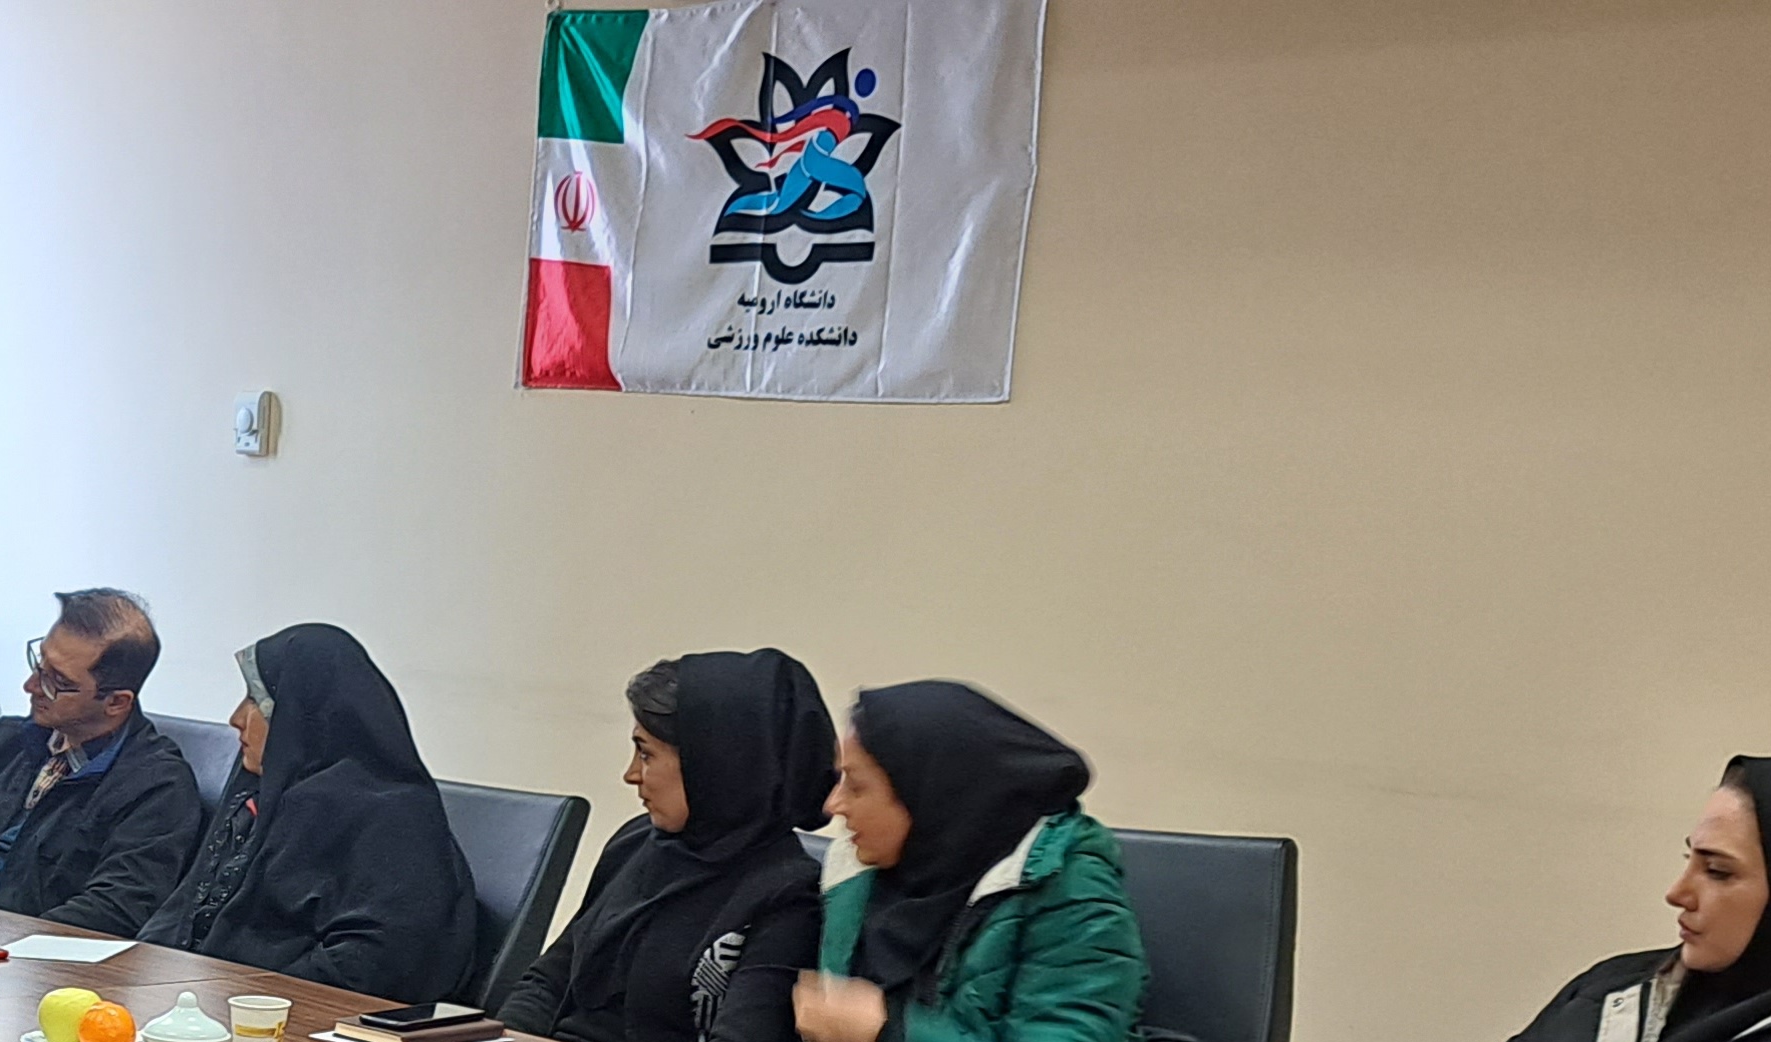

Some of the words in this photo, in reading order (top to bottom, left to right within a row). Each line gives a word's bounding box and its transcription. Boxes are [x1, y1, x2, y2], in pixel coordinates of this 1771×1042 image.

[737, 289, 782, 315] ارومیه
[784, 289, 836, 309] دانشگاه
[707, 324, 759, 351] ورزشی
[763, 325, 795, 352] علوم
[797, 325, 858, 347] دانشکده
